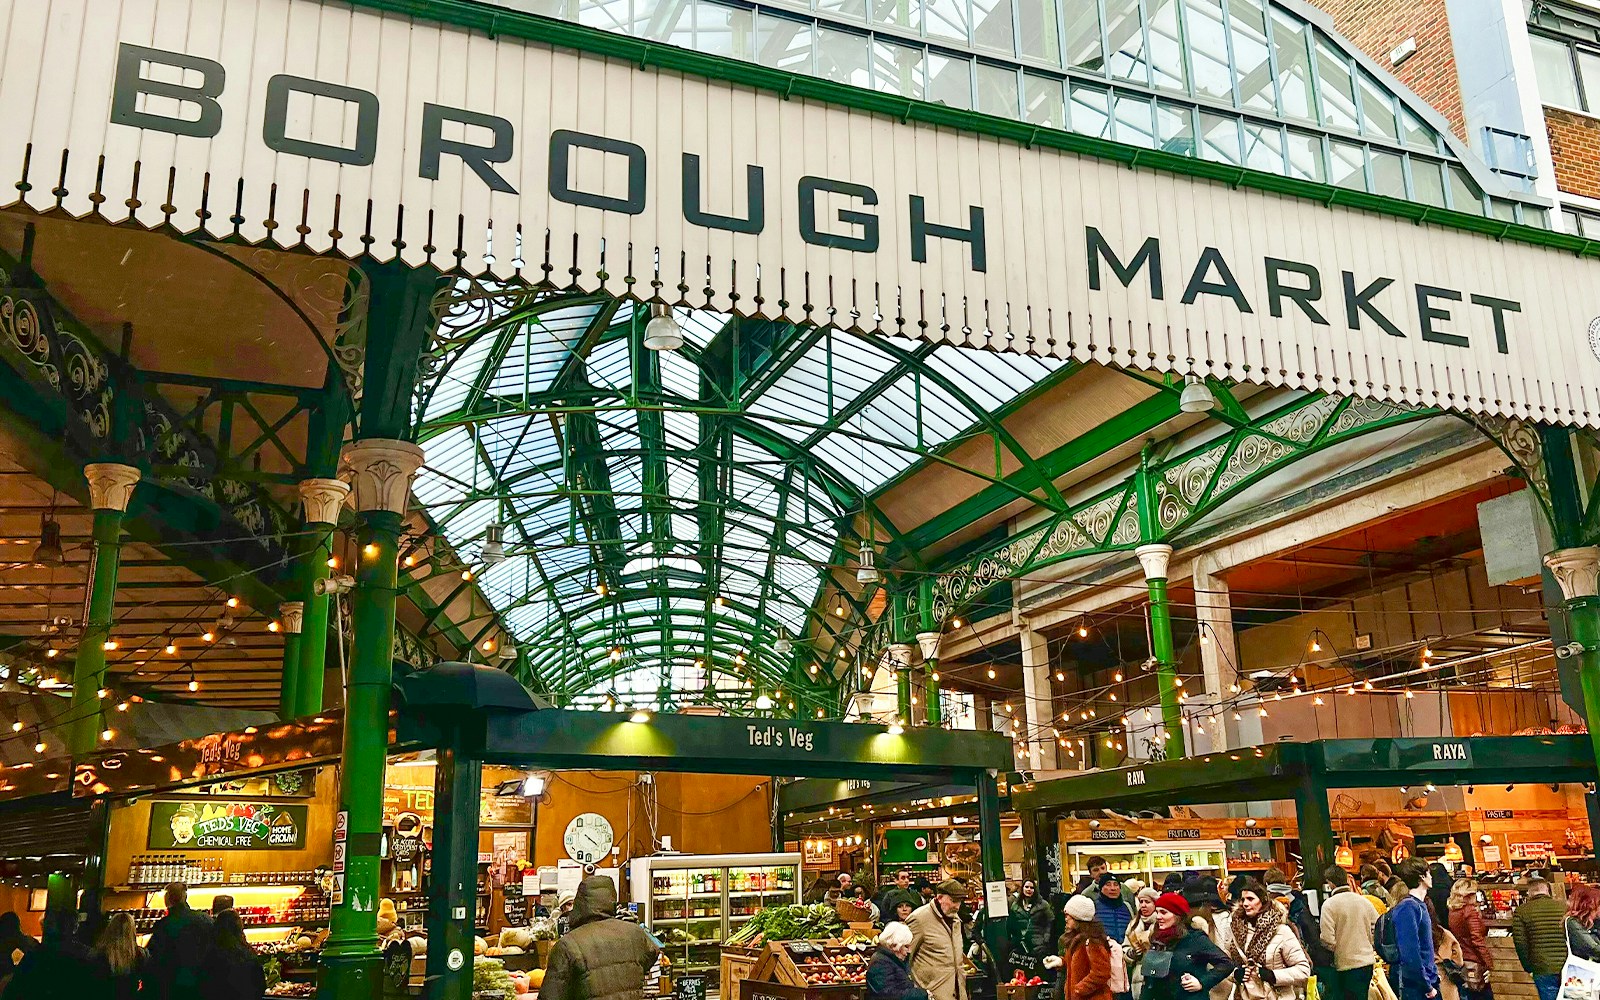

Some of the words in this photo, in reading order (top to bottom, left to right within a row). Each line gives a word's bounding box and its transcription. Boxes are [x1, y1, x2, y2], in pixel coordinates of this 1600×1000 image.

[110, 43, 987, 272] BOROUGH
[1085, 225, 1522, 355] MARKET
[747, 725, 783, 747] Ted's
[788, 727, 814, 752] Veg
[201, 742, 222, 764] Ted's
[225, 739, 242, 761] Veg
[1432, 743, 1467, 760] RAYA
[1127, 770, 1146, 786] RAYA
[1486, 810, 1506, 819] PASTE
[238, 816, 260, 834] VEG
[272, 826, 292, 834] HOME
[197, 836, 233, 847] CHEMICAL
[235, 836, 252, 847] FREE
[270, 833, 296, 844] GROWN
[1168, 829, 1183, 838] FRUIT
[1187, 829, 1199, 838] VEG
